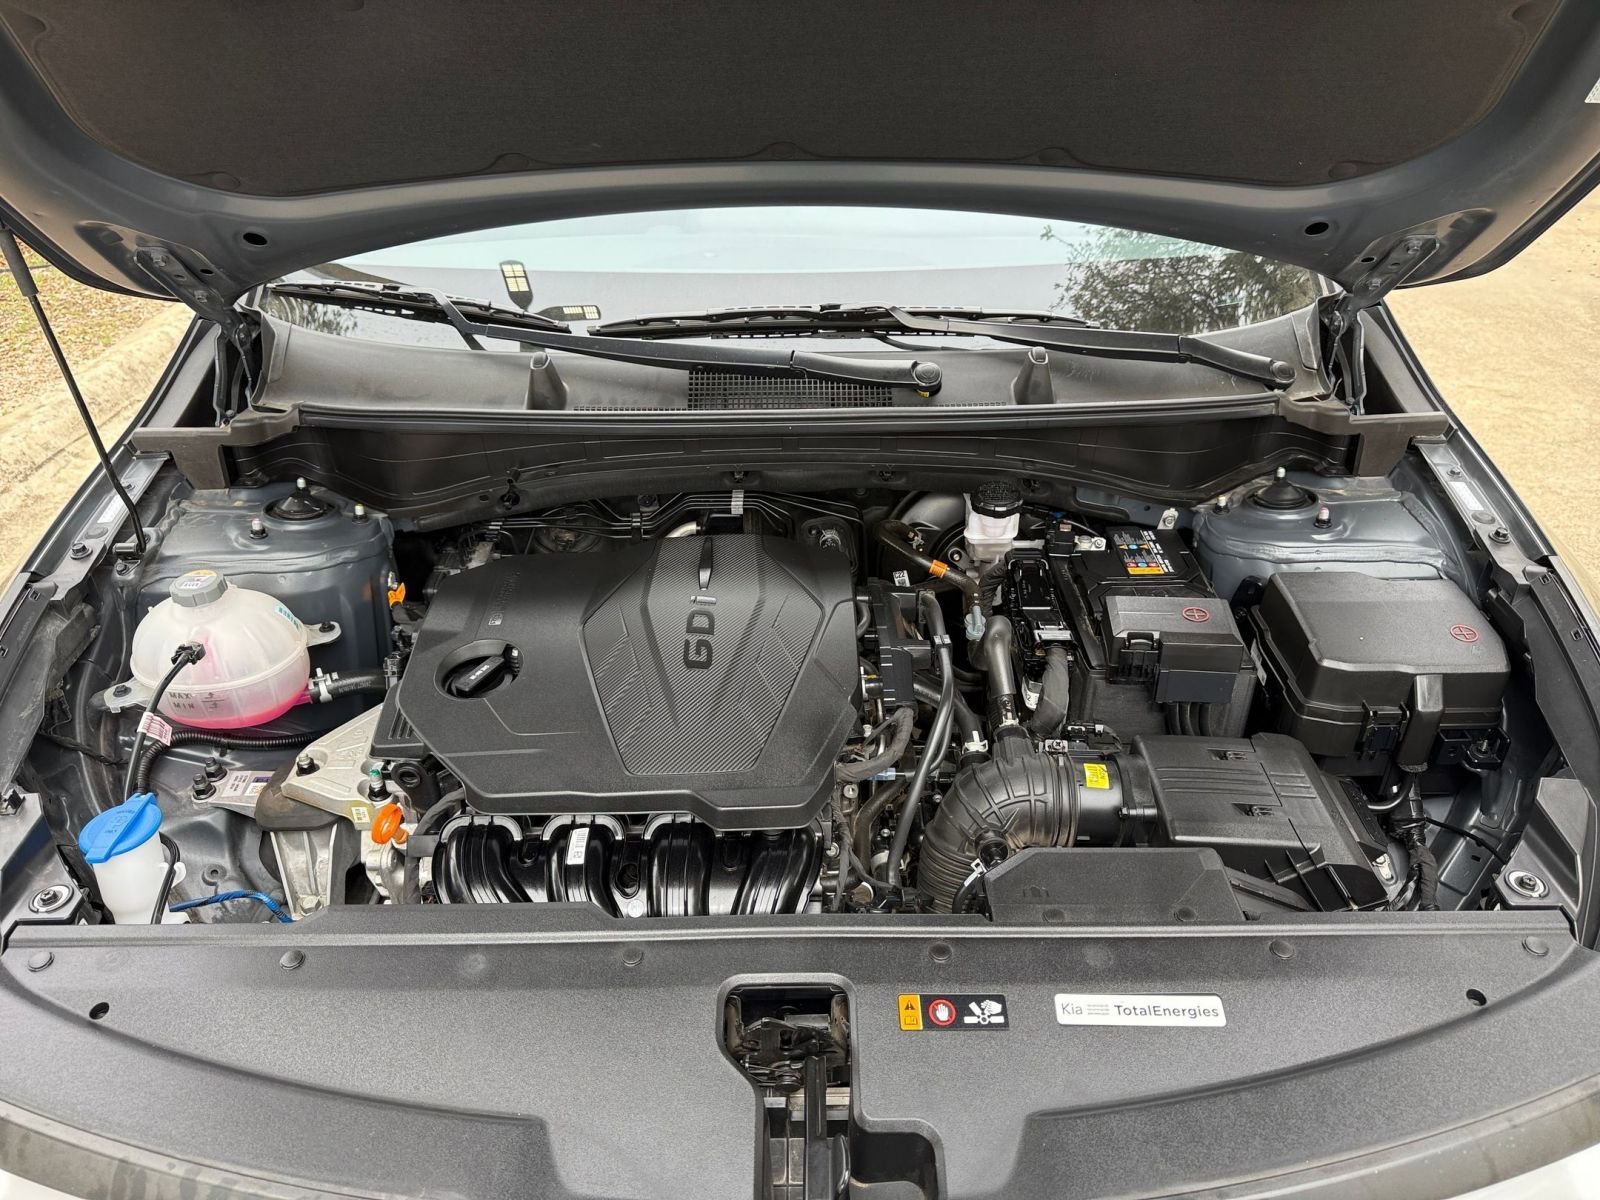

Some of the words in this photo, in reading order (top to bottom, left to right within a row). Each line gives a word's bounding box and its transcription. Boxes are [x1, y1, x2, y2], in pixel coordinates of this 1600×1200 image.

[169, 692, 192, 700] MAX
[1061, 1002, 1083, 1015] Kia
[1114, 1003, 1219, 1019] TotalEnergies
